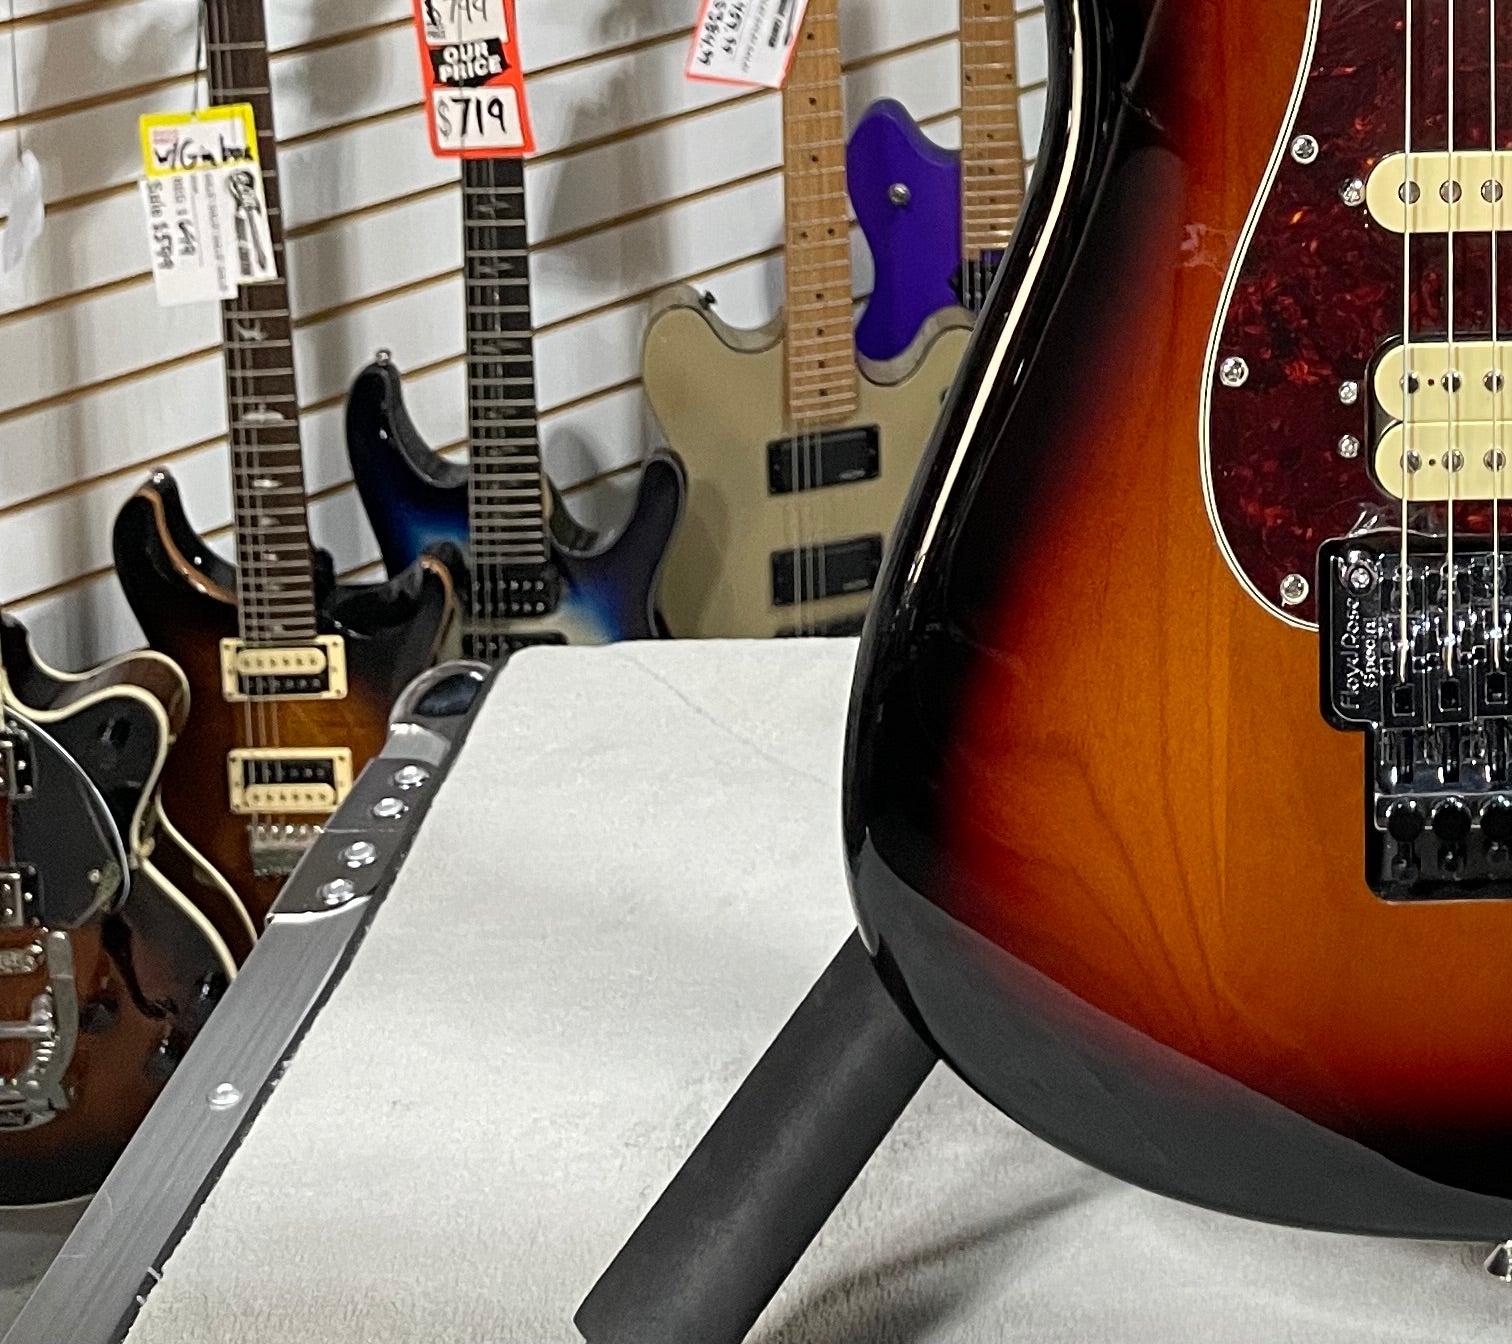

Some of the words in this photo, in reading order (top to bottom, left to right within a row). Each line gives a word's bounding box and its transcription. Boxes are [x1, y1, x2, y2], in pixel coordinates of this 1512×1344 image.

[438, 54, 504, 84] PRICE
[442, 39, 490, 65] OUR
[436, 96, 507, 142] $719
[1340, 596, 1360, 649] Rose
[1362, 616, 1379, 688] Special
[1340, 650, 1365, 710] Floyd
